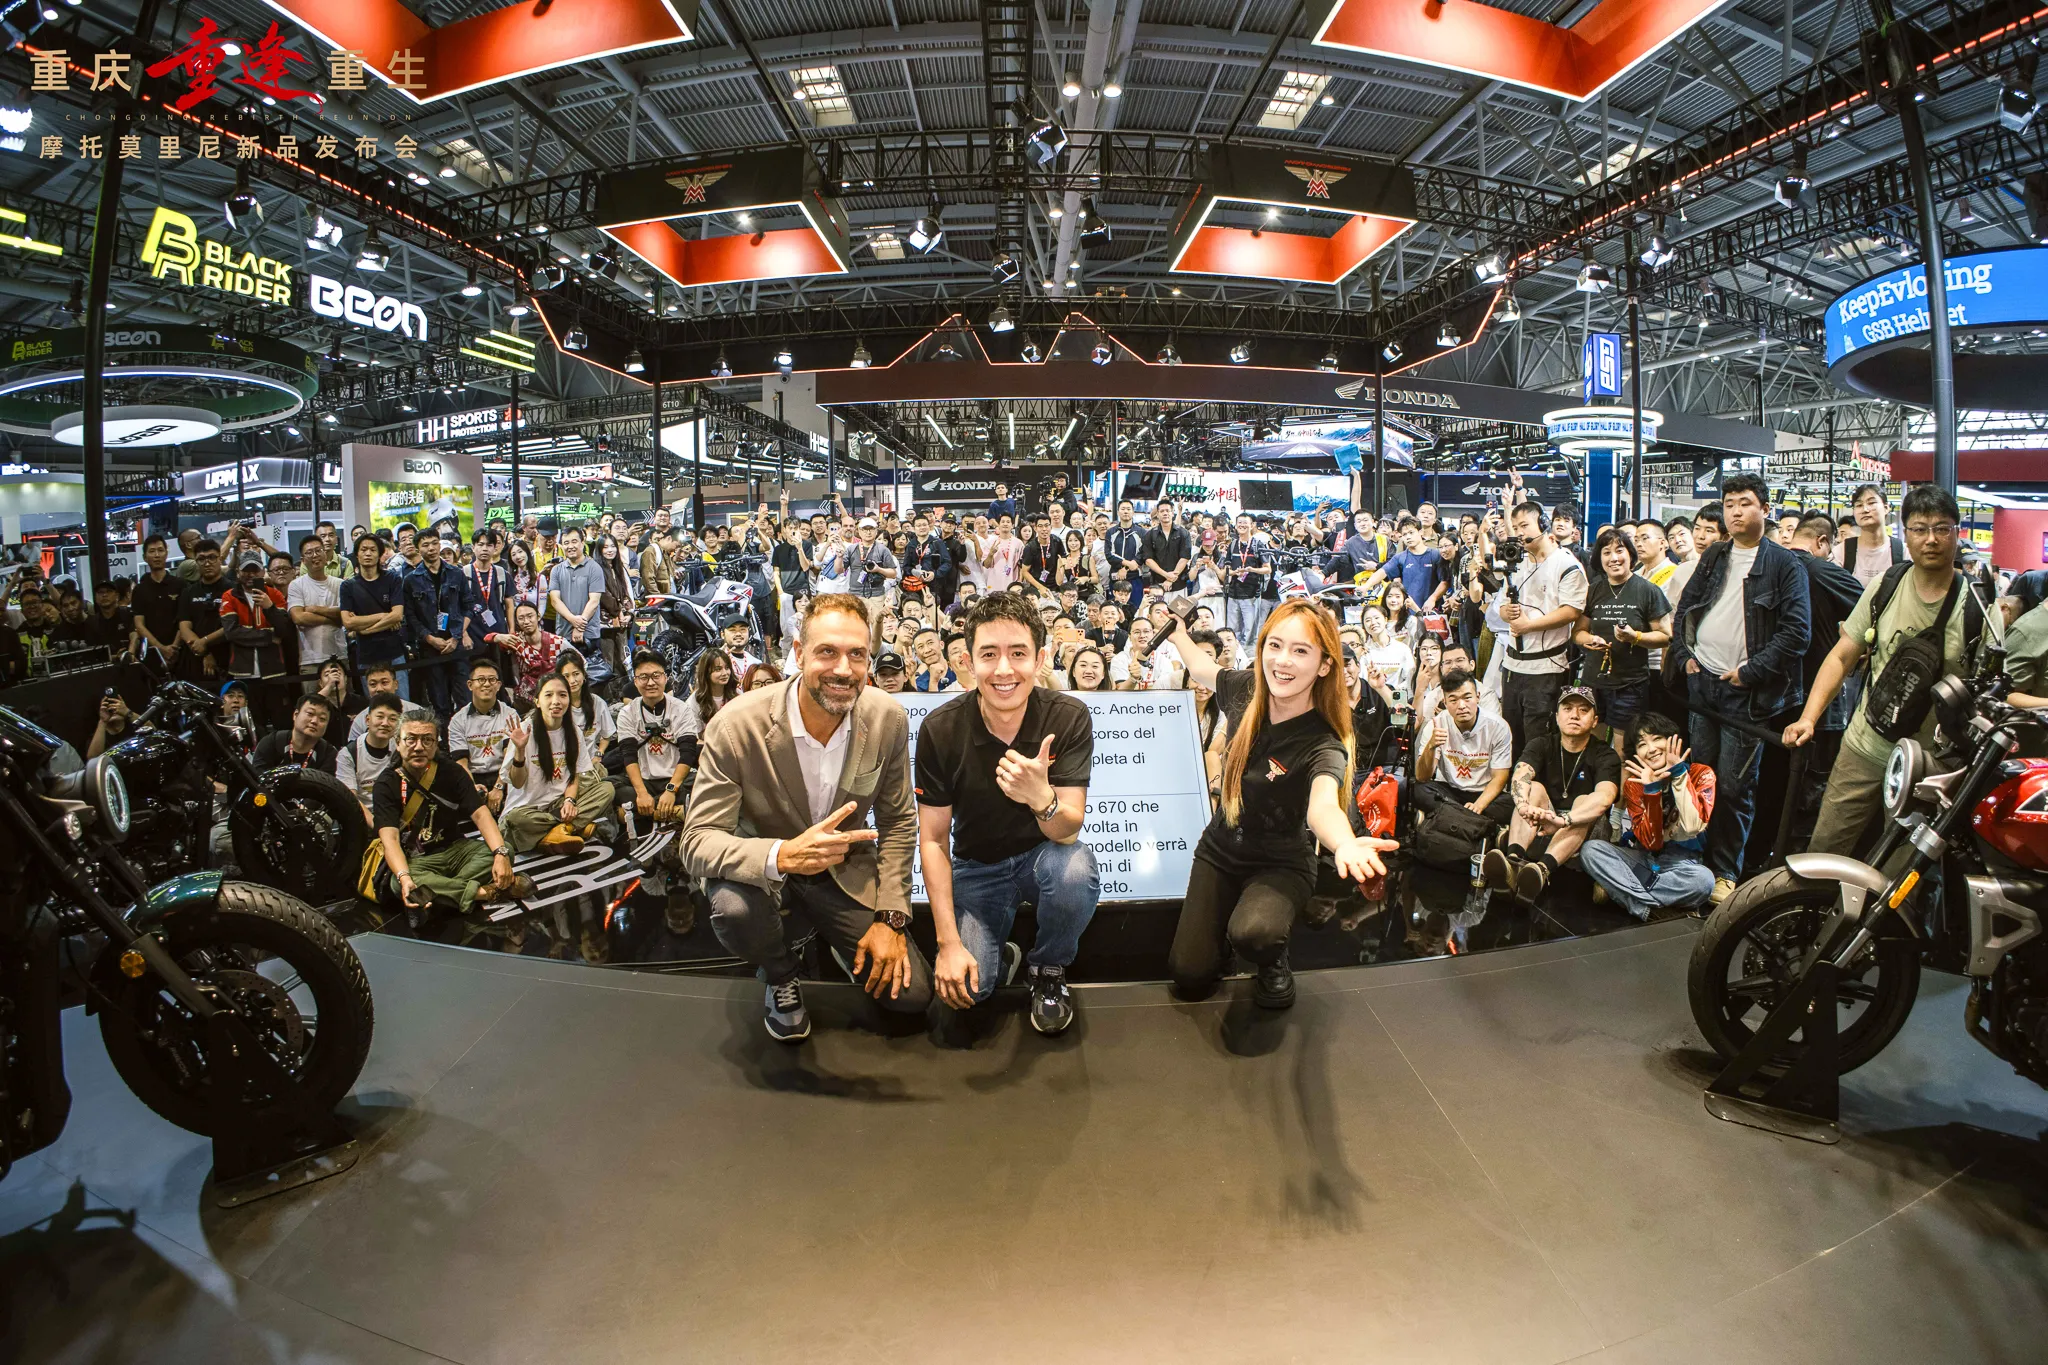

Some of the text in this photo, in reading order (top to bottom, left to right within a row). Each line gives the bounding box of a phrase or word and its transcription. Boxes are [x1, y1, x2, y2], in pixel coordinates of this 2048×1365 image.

[205, 239, 293, 285] BLACK
[203, 264, 292, 306] RIDER
[1838, 261, 1992, 324] KeepEvloing
[1891, 303, 1968, 335] Helet
[26, 347, 53, 357] RIDER
[27, 340, 53, 351] BLACK
[1364, 386, 1461, 409] HONDA
[662, 400, 680, 409] 6T10
[450, 409, 498, 428] SPORTS
[450, 423, 498, 438] PROTECTION
[898, 470, 912, 483] 12
[940, 481, 997, 491] HONDA
[1479, 486, 1540, 497] HOA
[1109, 703, 1156, 715] Anche
[1158, 704, 1182, 718] per
[1133, 727, 1156, 739] del
[1133, 751, 1146, 764] di
[1099, 801, 1127, 814] 670
[1131, 801, 1160, 813] che
[1083, 821, 1138, 834] volta in
[1118, 860, 1132, 873] di
